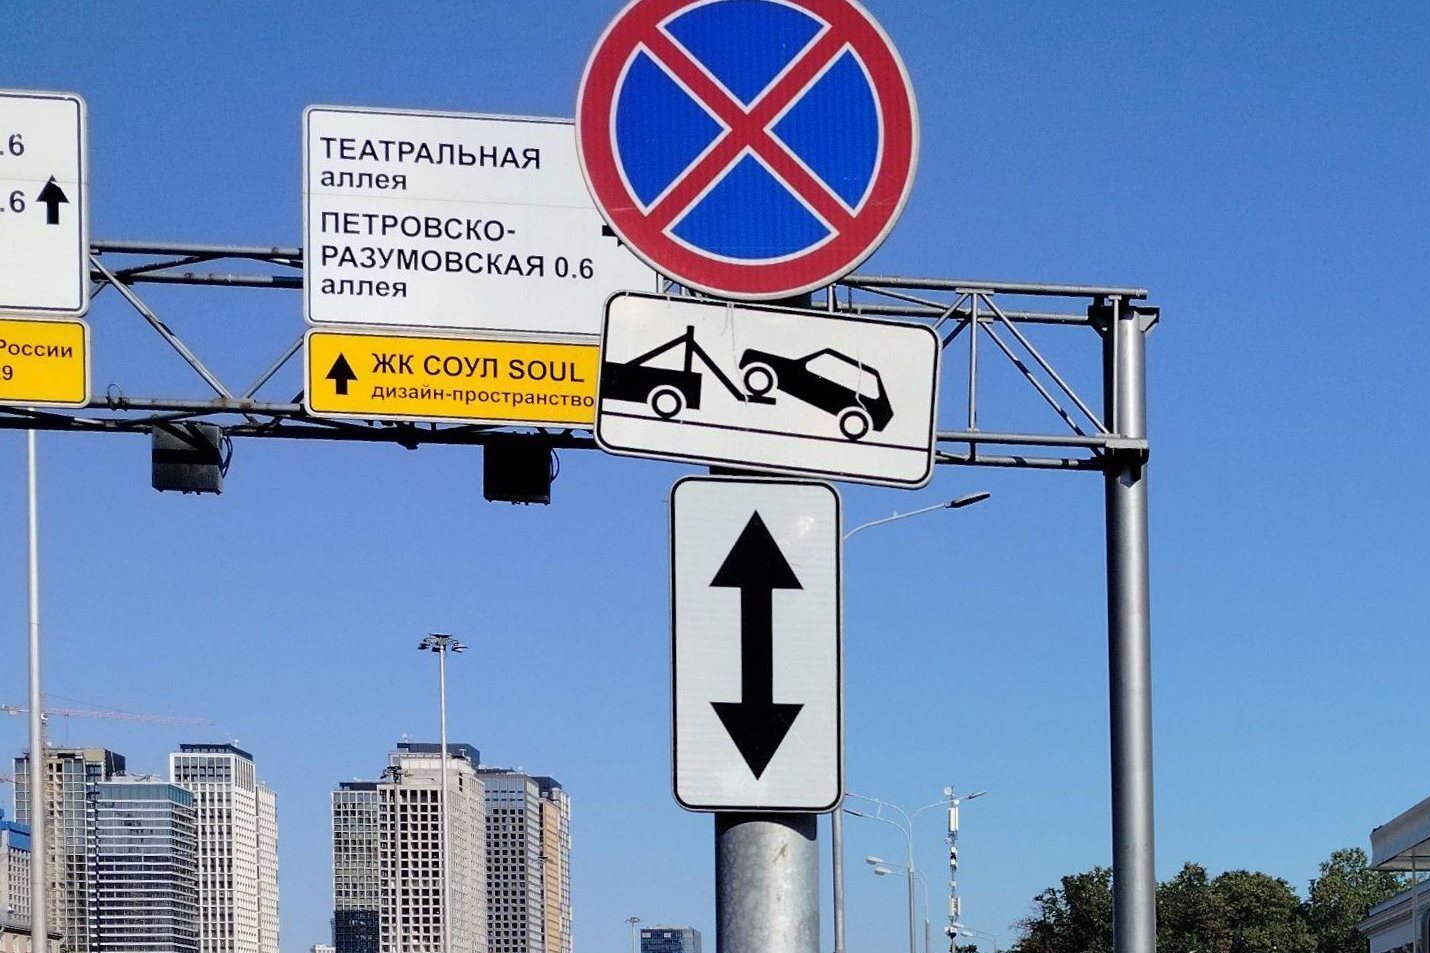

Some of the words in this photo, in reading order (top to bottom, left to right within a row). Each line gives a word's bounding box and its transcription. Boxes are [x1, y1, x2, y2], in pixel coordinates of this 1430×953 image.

[320, 137, 541, 169] ТЕАТРАЛЬНАЯ
[320, 170, 407, 190] аллея
[321, 211, 516, 242] ПЕТРОВСКО-
[321, 245, 545, 277] РАЗУМОВСКАЯ
[554, 256, 594, 279] 0.6
[321, 278, 407, 297] аллея
[371, 353, 414, 375] ЖК
[423, 355, 498, 378] СОУЛ
[508, 359, 585, 382] SOUL
[371, 384, 594, 407] дизайн-пространство
